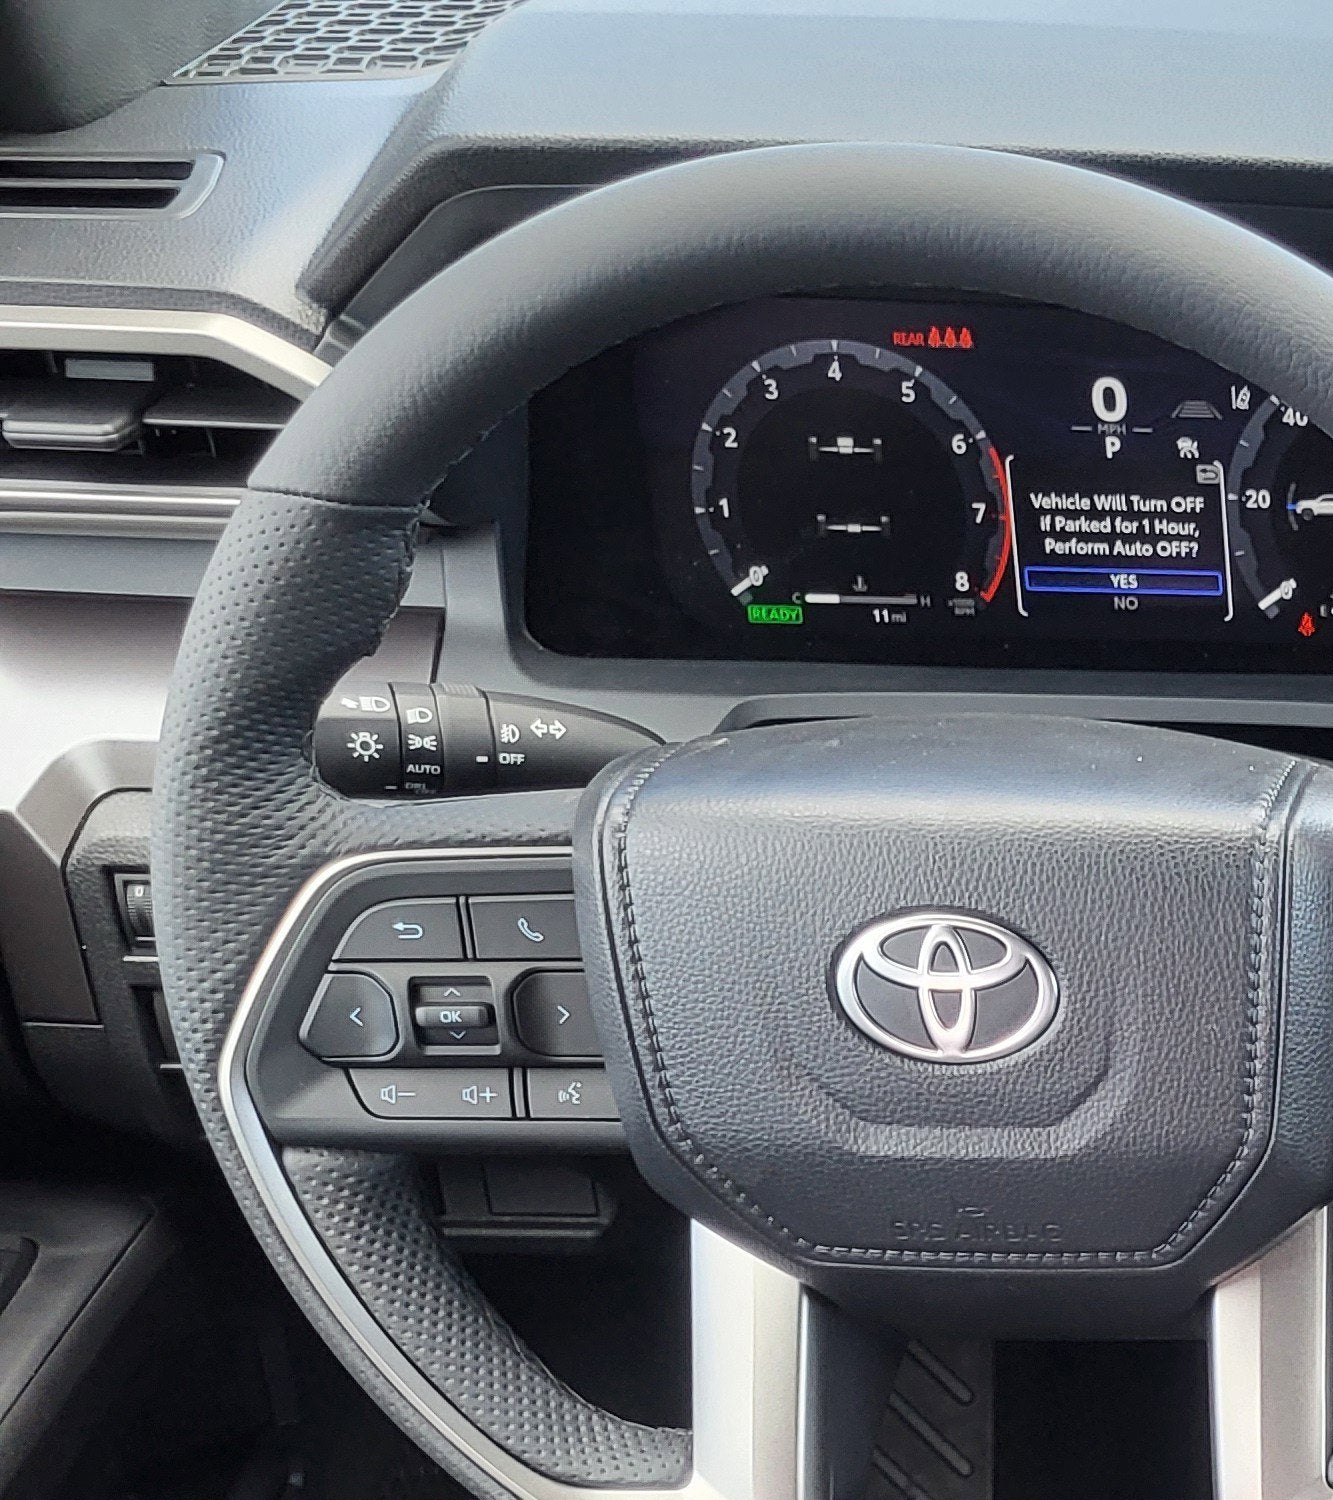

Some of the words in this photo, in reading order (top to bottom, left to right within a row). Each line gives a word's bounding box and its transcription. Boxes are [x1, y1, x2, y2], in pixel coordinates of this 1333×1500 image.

[827, 361, 841, 381] 4
[763, 379, 779, 400] 3
[901, 381, 917, 403] 5
[1091, 377, 1128, 423] 0
[723, 427, 739, 449] 2
[1097, 423, 1127, 436] MPH
[951, 433, 968, 454] 6
[1105, 436, 1121, 459] P
[719, 498, 731, 519] 1
[1030, 492, 1091, 511] Vehicle
[1093, 493, 1128, 512] Will
[1130, 495, 1168, 513] Turn
[1170, 496, 1204, 514] OFF
[1245, 489, 1271, 508] 20
[971, 502, 987, 523] 7
[1054, 515, 1112, 534] Parked
[1114, 516, 1139, 534] for
[1142, 518, 1151, 535] 1
[1154, 518, 1200, 538] Hour,
[1044, 537, 1110, 555] Perform
[1113, 540, 1154, 557] Auto
[1156, 541, 1199, 558] OFF?
[748, 566, 764, 587] 0
[955, 572, 970, 592] 8
[1109, 574, 1139, 589] YES
[751, 606, 799, 621] READY
[1113, 596, 1139, 610] NO
[872, 608, 890, 624] 11
[405, 764, 441, 775] AUTO
[499, 753, 525, 767] OFF
[440, 1010, 463, 1024] OK
